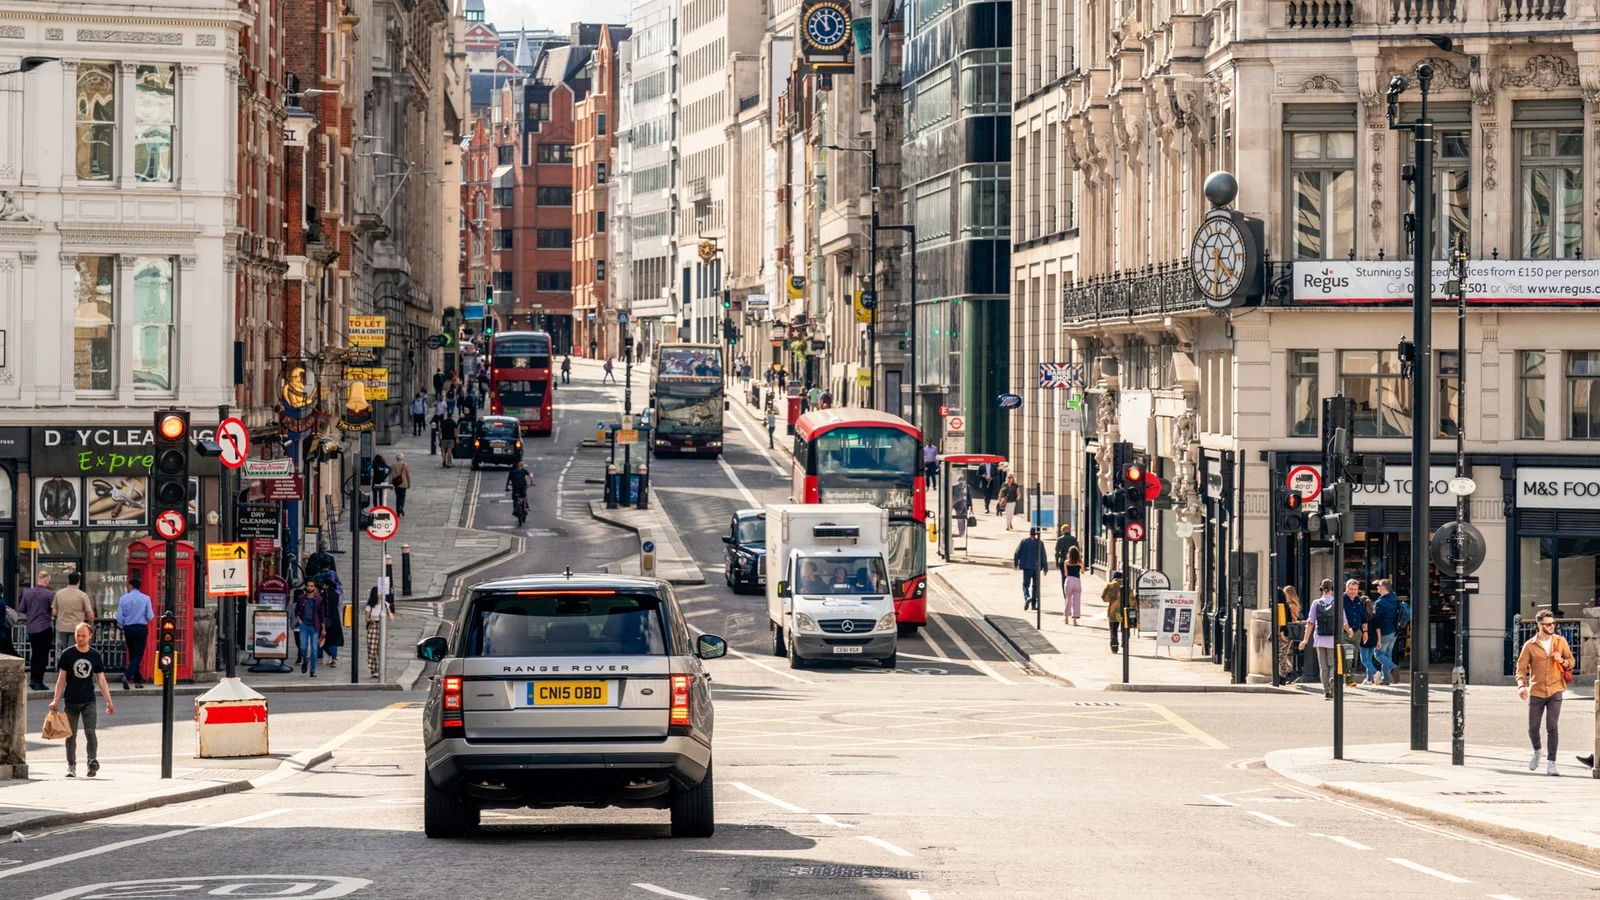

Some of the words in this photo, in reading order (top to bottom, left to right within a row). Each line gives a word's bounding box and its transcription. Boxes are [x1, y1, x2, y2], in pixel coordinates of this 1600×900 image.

[1356, 267, 1401, 279] Stunning
[1404, 267, 1449, 277] Seced
[1453, 266, 1489, 277] Oices
[1491, 267, 1515, 277] from
[1518, 268, 1543, 277] £150
[1546, 269, 1562, 278] per
[1564, 269, 1599, 279] person
[1304, 274, 1349, 293] Regus
[1387, 282, 1405, 293] Call
[1491, 285, 1501, 293] or
[1503, 284, 1523, 293] visit
[364, 320, 382, 328] LET
[941, 407, 947, 415] E
[1352, 480, 1390, 494] OOD
[1524, 481, 1558, 496] M&S
[222, 567, 236, 580] 17
[1143, 577, 1164, 587] Regus
[540, 686, 570, 700] CN15
[574, 686, 602, 700] OBD
